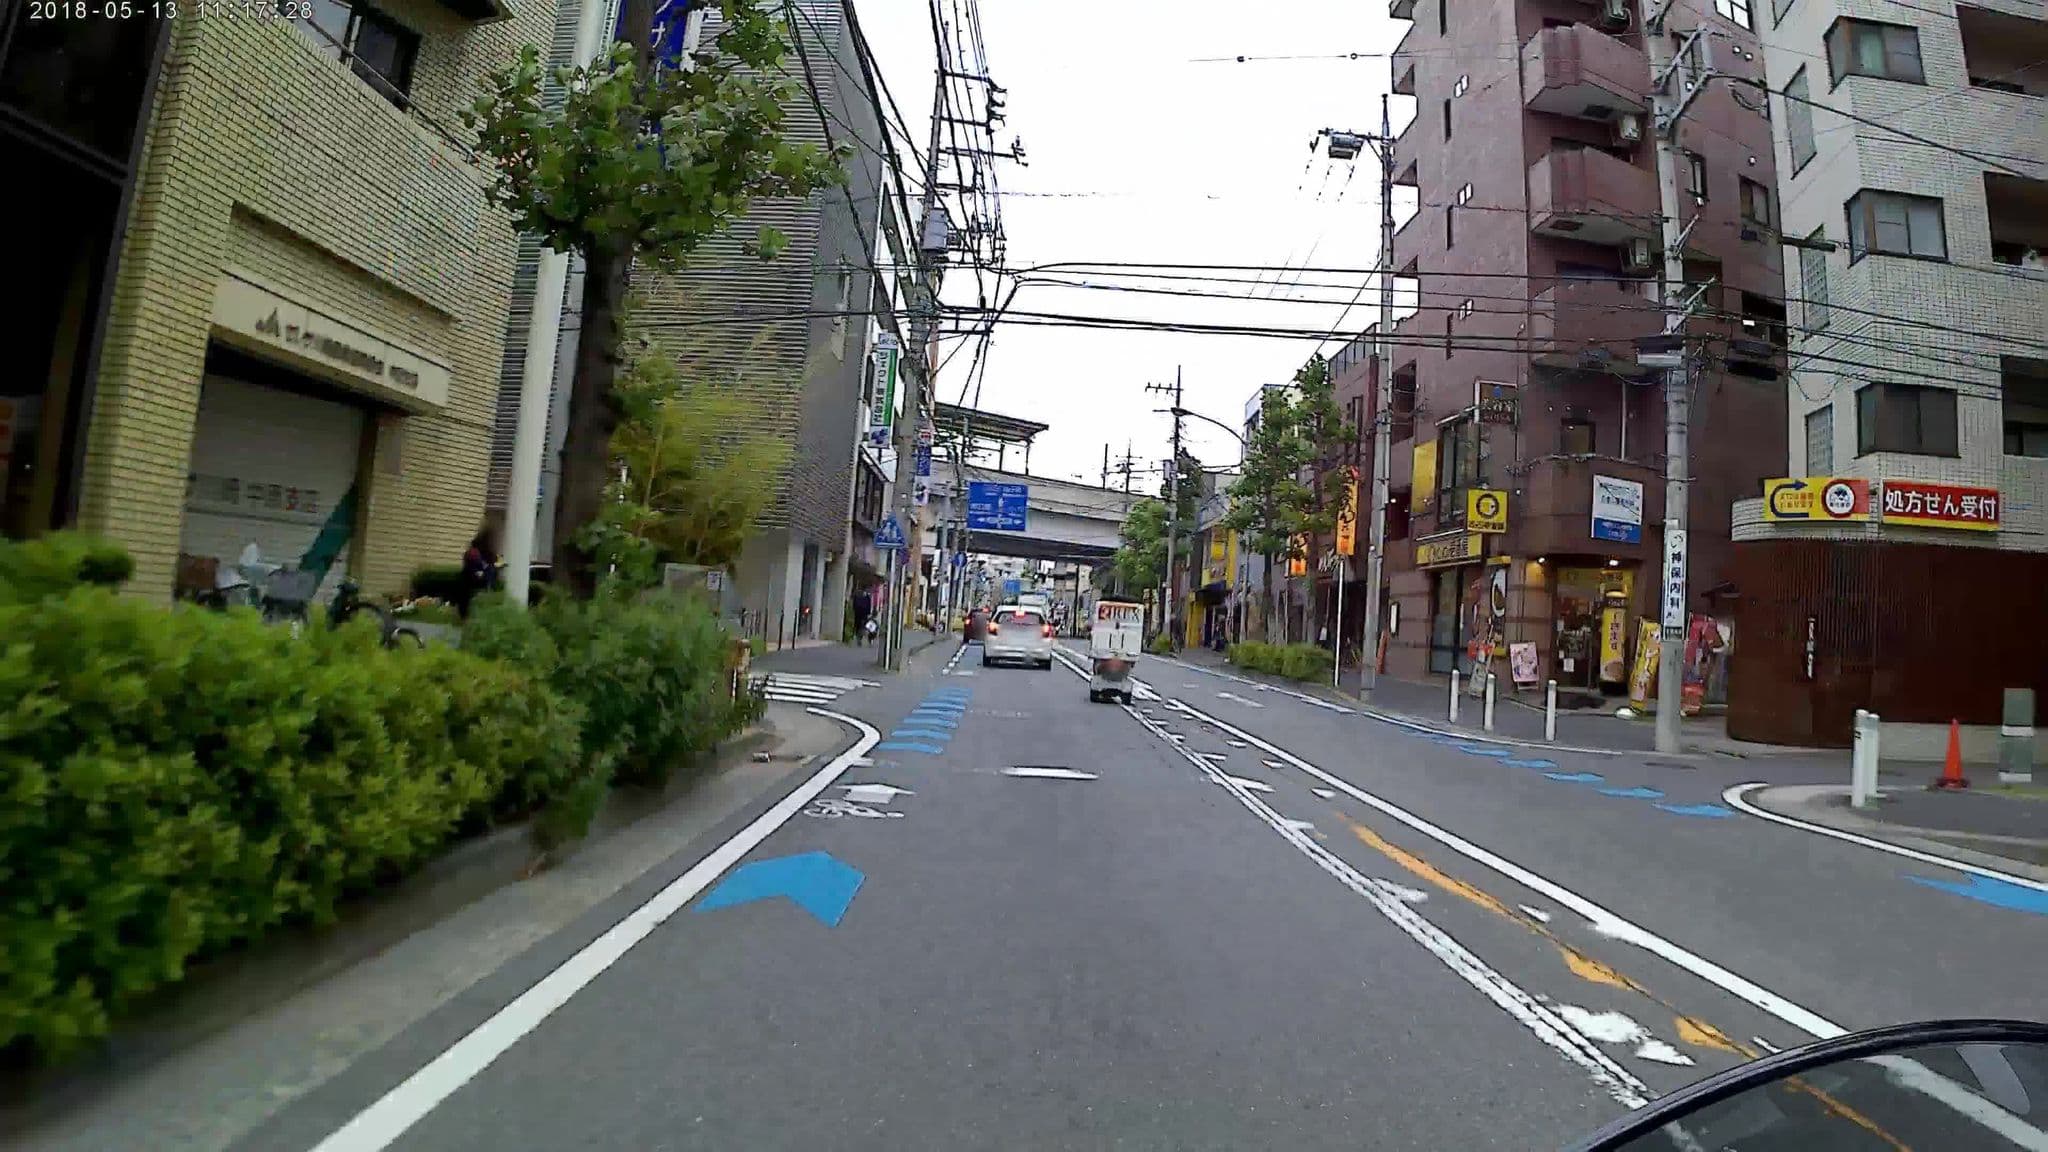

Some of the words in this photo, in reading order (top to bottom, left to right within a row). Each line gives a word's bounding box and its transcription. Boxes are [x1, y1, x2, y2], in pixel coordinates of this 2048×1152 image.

[1885, 488, 1997, 520] 処方せん受付
